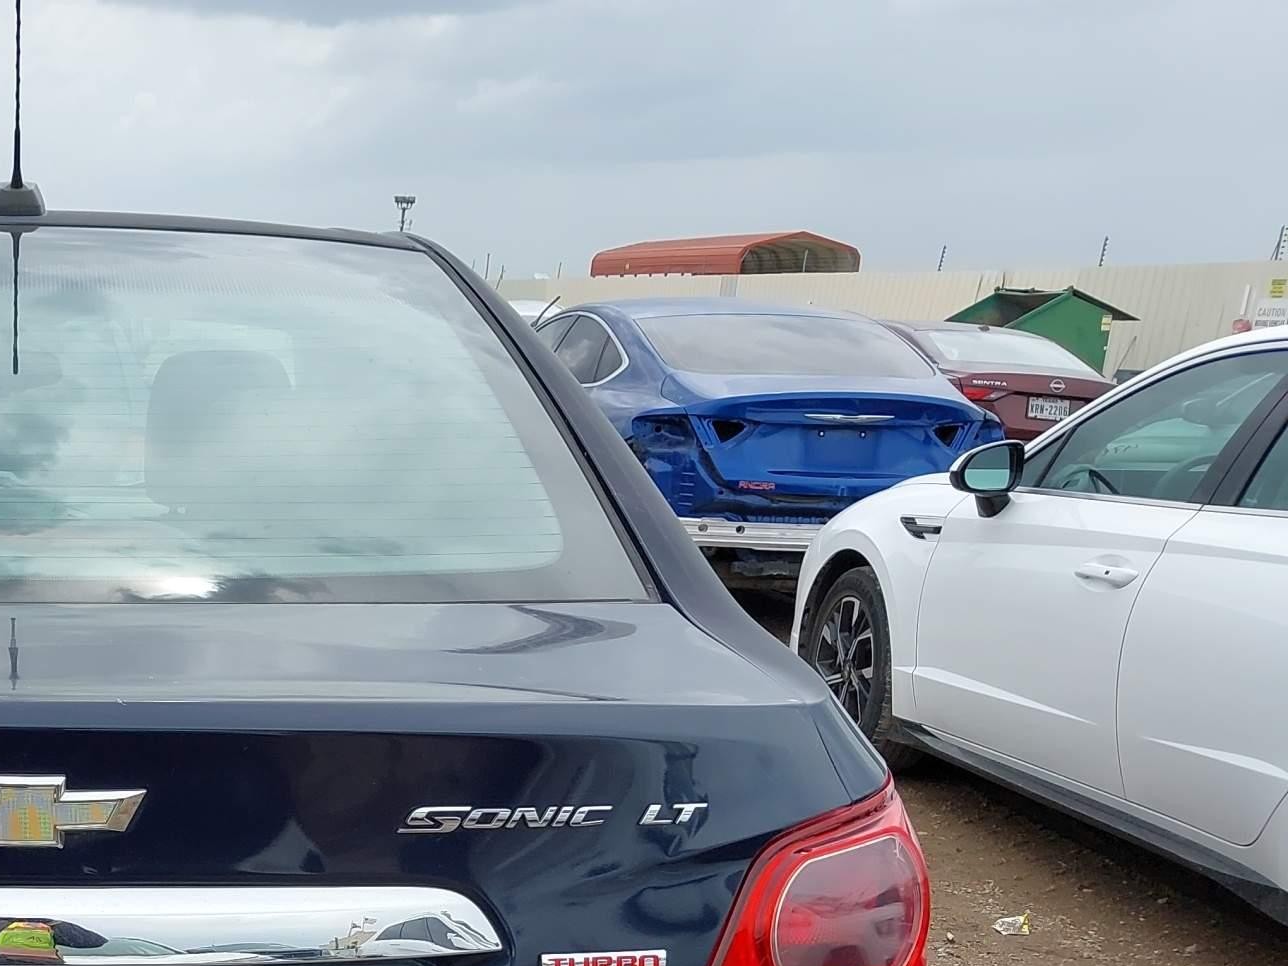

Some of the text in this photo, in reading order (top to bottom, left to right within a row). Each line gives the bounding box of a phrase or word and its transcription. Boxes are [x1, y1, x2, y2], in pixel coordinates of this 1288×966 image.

[1257, 307, 1286, 317] CAUTION
[397, 802, 709, 834] SONIC LT
